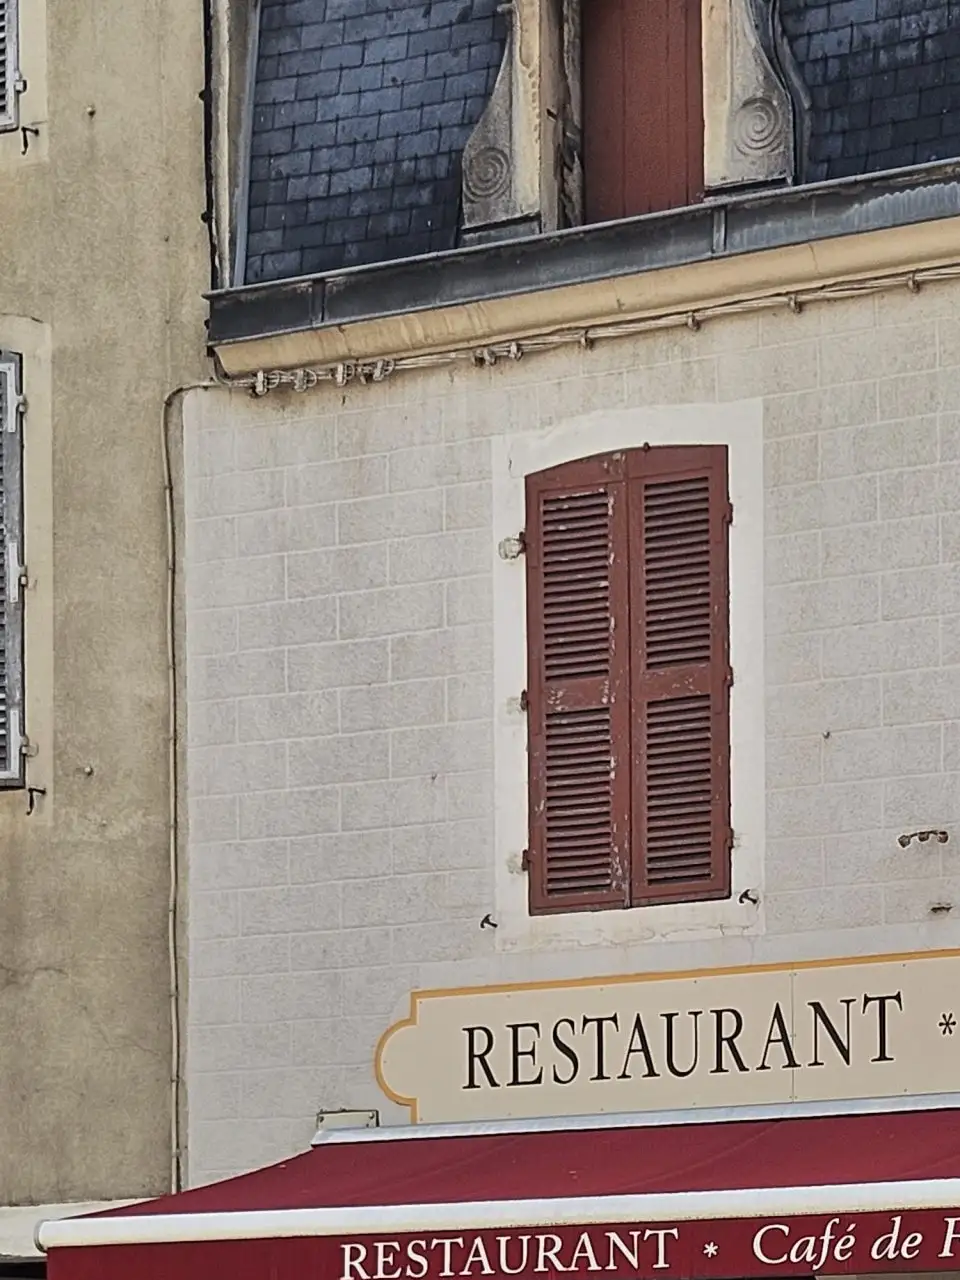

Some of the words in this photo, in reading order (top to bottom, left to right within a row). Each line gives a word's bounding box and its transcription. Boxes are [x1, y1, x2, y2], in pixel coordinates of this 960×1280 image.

[461, 991, 903, 1090] RESTAURANT
[752, 1217, 857, 1271] Café
[871, 1216, 923, 1261] de
